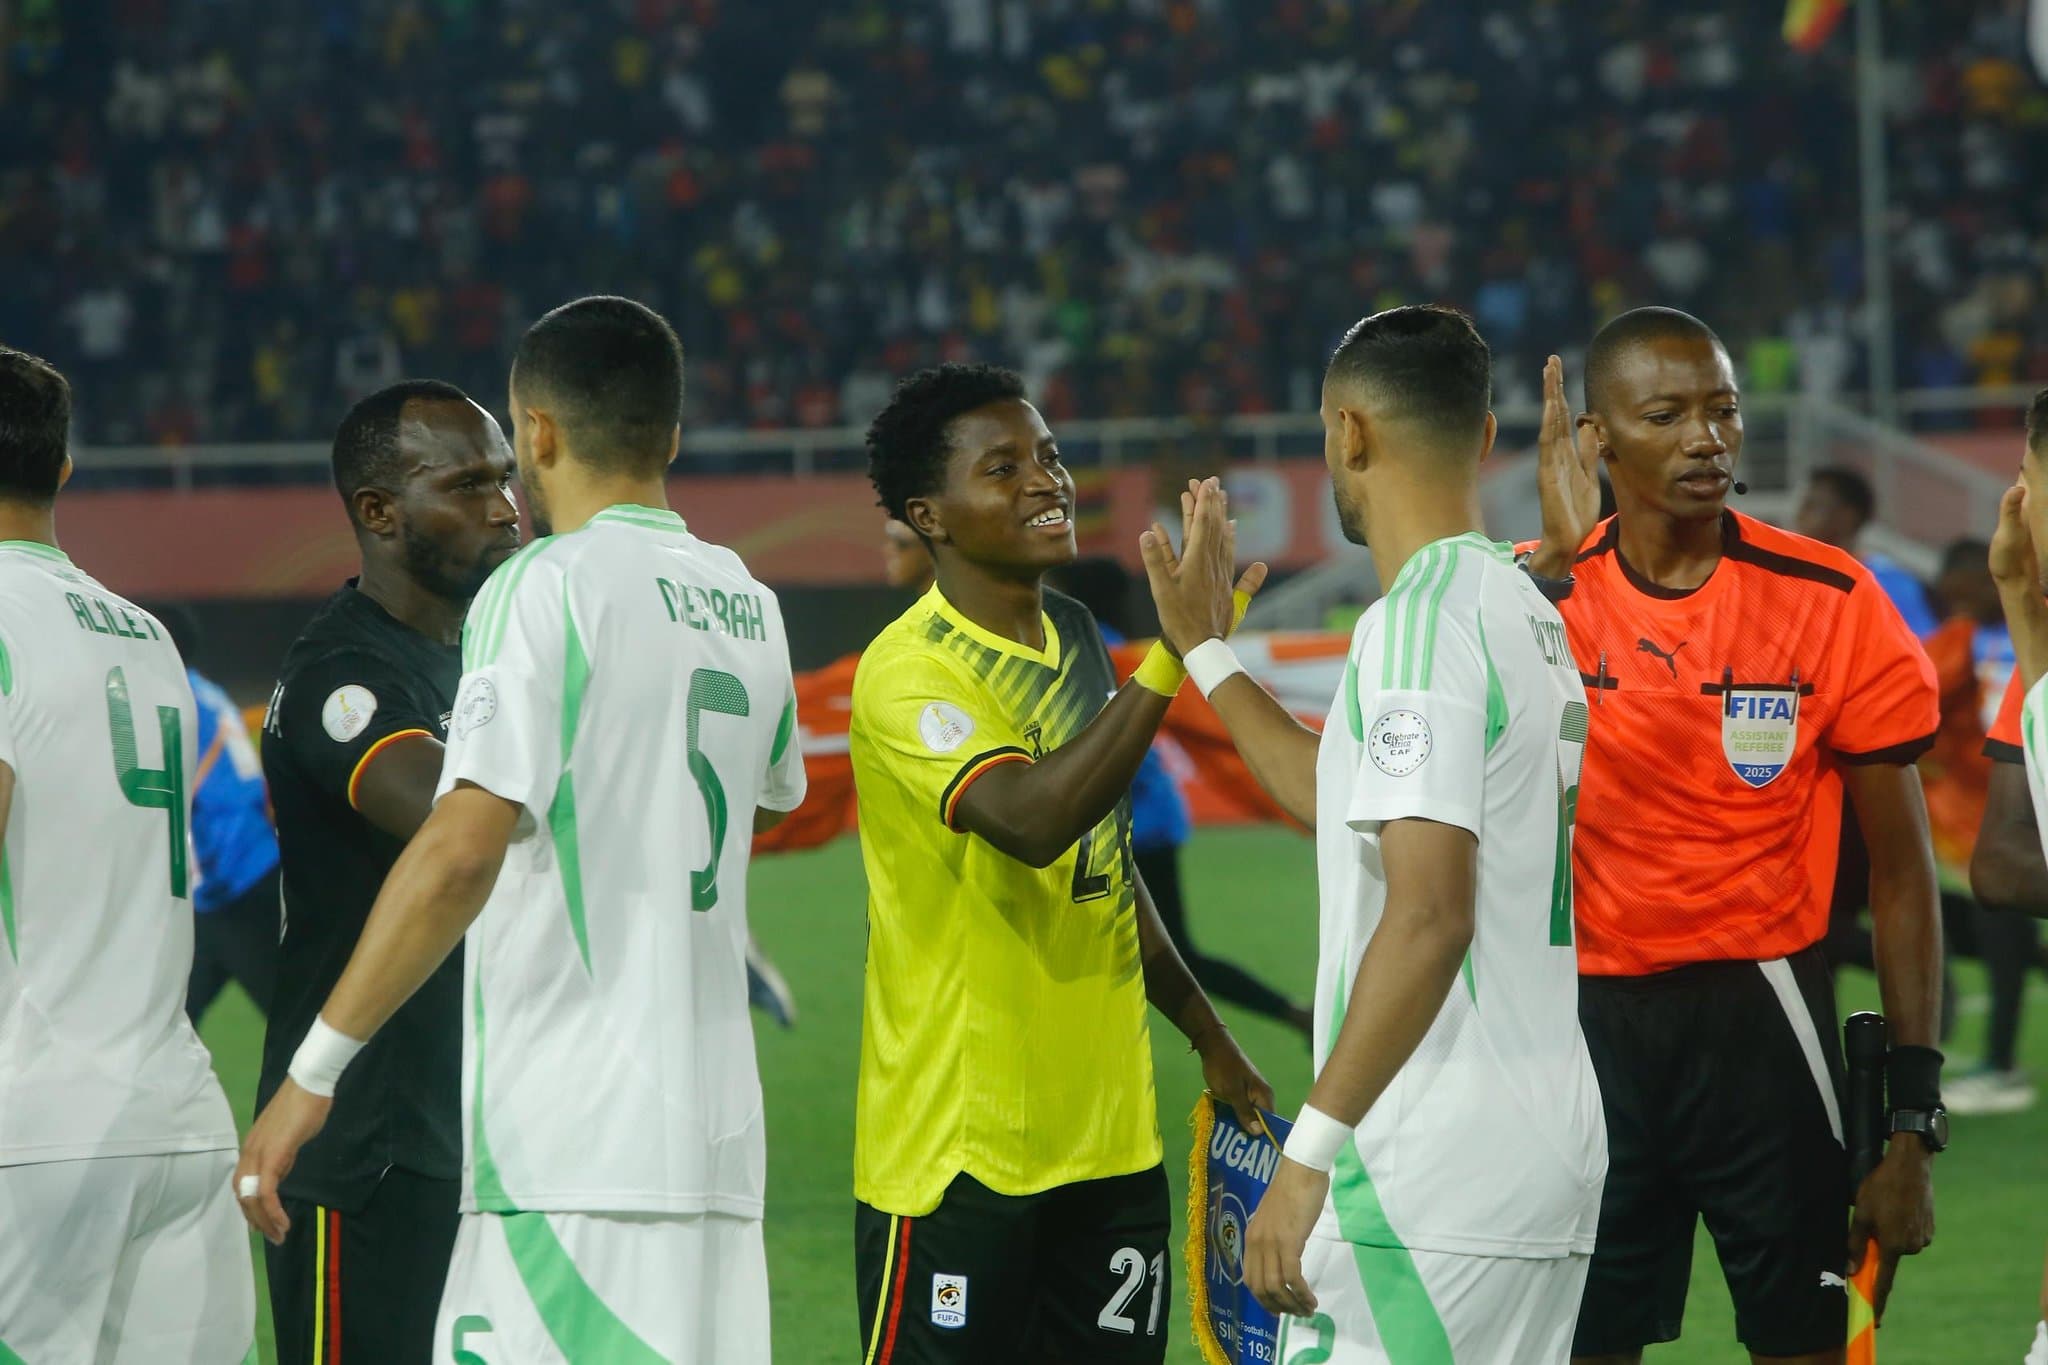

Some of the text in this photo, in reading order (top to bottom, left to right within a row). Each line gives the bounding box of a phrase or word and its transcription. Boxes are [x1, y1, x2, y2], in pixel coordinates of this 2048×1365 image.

[1731, 697, 1792, 720] FIFA
[1730, 731, 1789, 741] ASSISTANT
[1735, 742, 1785, 752] REFEREE
[1744, 767, 1772, 778] 2025
[106, 665, 187, 899] 4
[686, 667, 750, 912] 5
[1097, 1247, 1165, 1336] 21
[936, 1313, 959, 1323] FUFA
